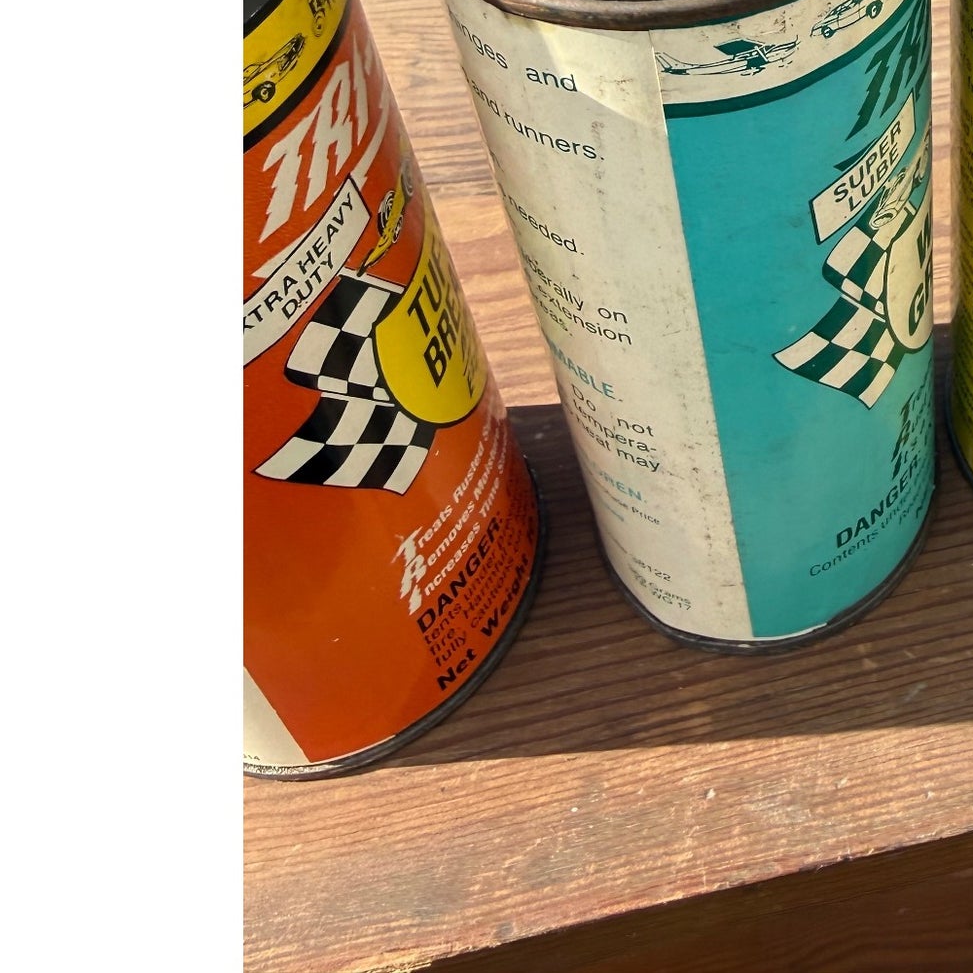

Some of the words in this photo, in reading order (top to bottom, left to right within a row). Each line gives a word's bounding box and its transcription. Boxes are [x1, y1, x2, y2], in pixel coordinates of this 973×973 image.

[525, 66, 578, 93] and
[503, 111, 605, 161] runners.
[833, 119, 902, 204] SUPER
[848, 146, 899, 212] LUBE
[297, 192, 354, 275] HEAVY
[508, 194, 585, 256] needed.
[281, 251, 334, 320] DUTY
[597, 307, 628, 324] on
[571, 383, 596, 412] Do
[617, 417, 654, 438] not
[616, 447, 661, 473] may
[436, 648, 477, 691] Net
